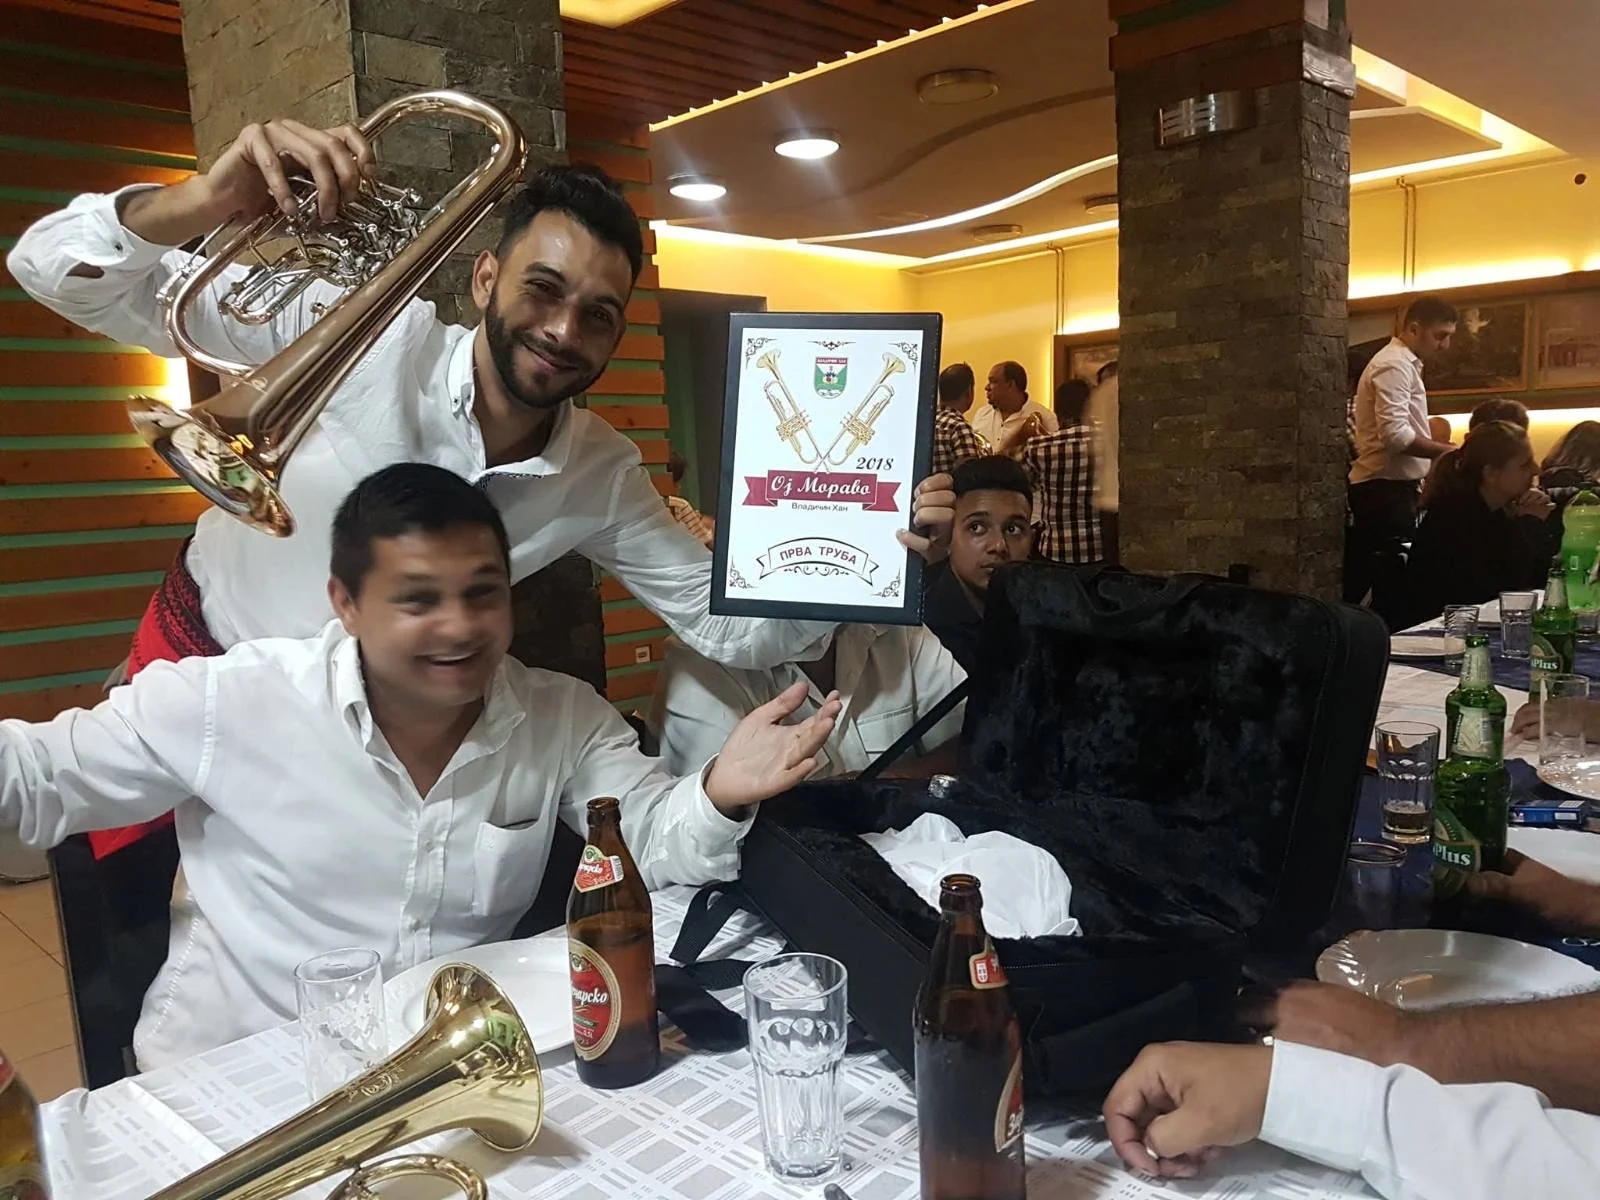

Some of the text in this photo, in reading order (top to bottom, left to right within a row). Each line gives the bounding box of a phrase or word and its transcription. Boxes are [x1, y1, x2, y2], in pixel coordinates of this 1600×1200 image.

[856, 456, 894, 471] 2018
[797, 476, 871, 498] Мораво
[791, 502, 848, 512] Владичин Хан
[779, 546, 857, 565] ПРВА ТРУБА
